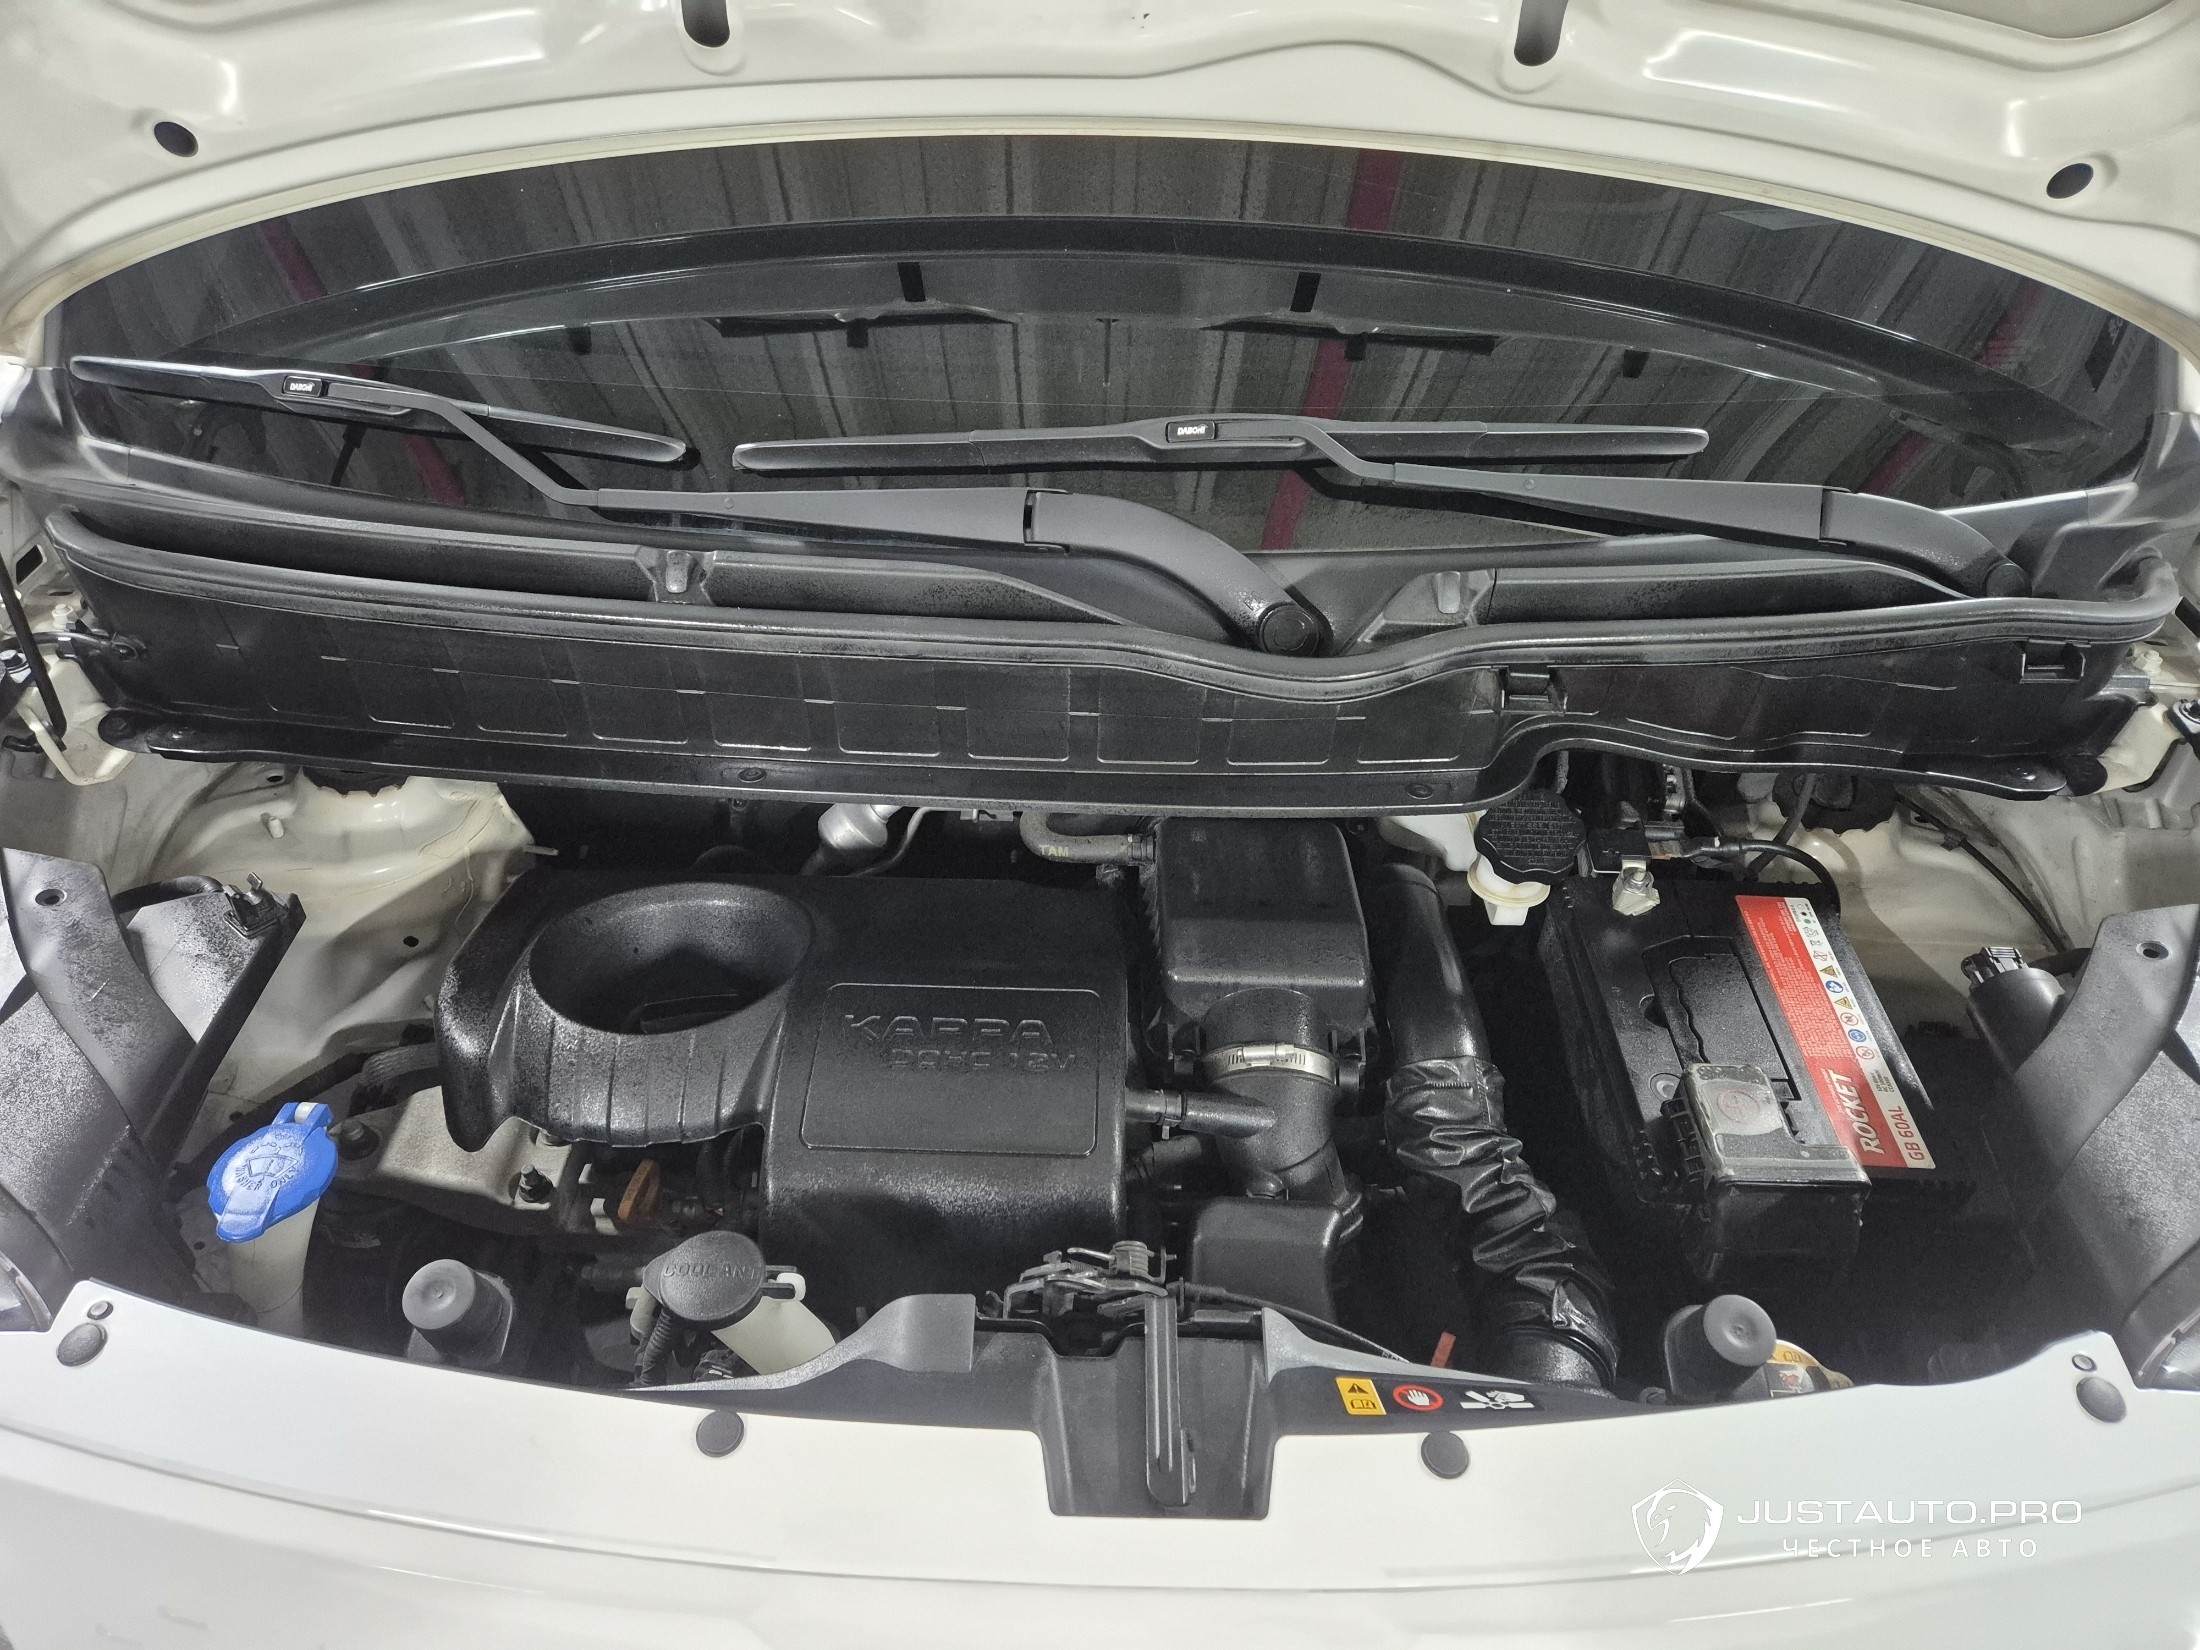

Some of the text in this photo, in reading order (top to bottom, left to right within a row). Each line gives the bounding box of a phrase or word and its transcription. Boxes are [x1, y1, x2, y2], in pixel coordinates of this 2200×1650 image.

[1039, 844, 1069, 857] TAM
[845, 1014, 1053, 1045] KAPPA
[1009, 1052, 1076, 1073] 12V
[1828, 1069, 1885, 1155] ROCKET
[1888, 1106, 1925, 1161] GB 60AL
[270, 1166, 297, 1189] ONLY
[663, 1262, 756, 1281] COOLANT
